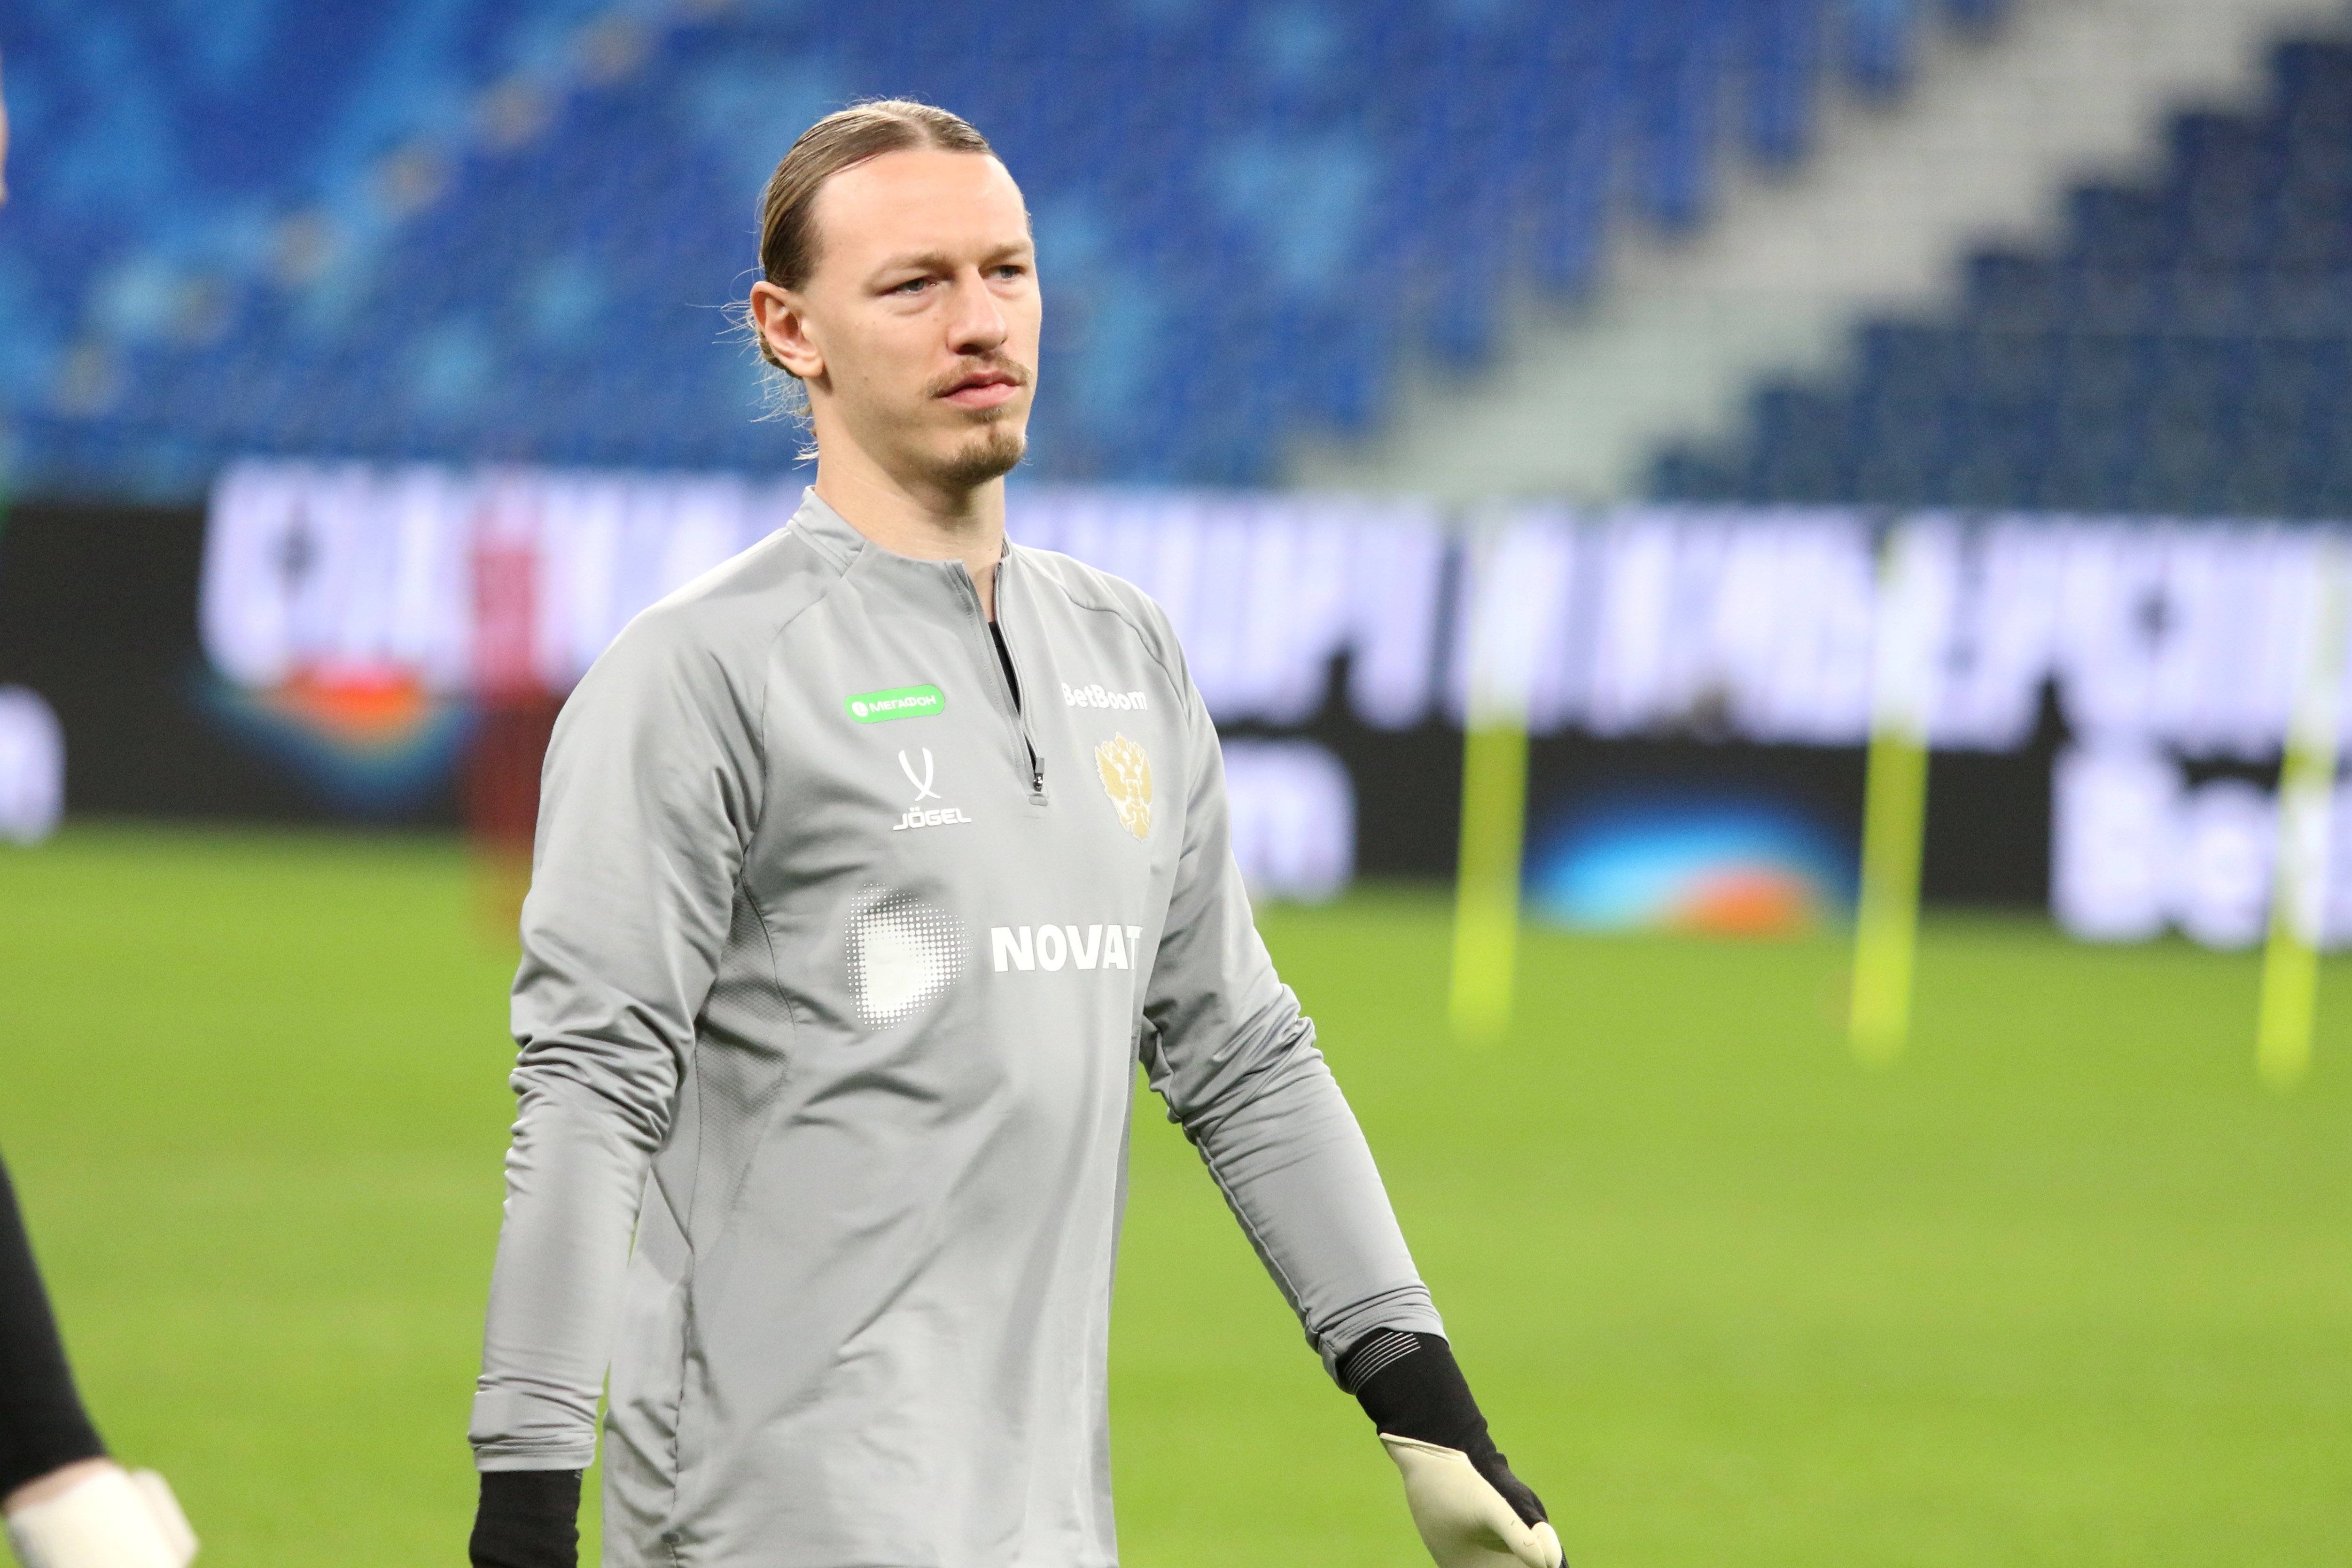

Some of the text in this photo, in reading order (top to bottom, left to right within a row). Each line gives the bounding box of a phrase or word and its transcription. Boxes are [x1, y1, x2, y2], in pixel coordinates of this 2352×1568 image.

[869, 695, 936, 713] МЕГАФОН
[1061, 682, 1148, 711] BetBoom
[893, 806, 972, 831] JÖGEL
